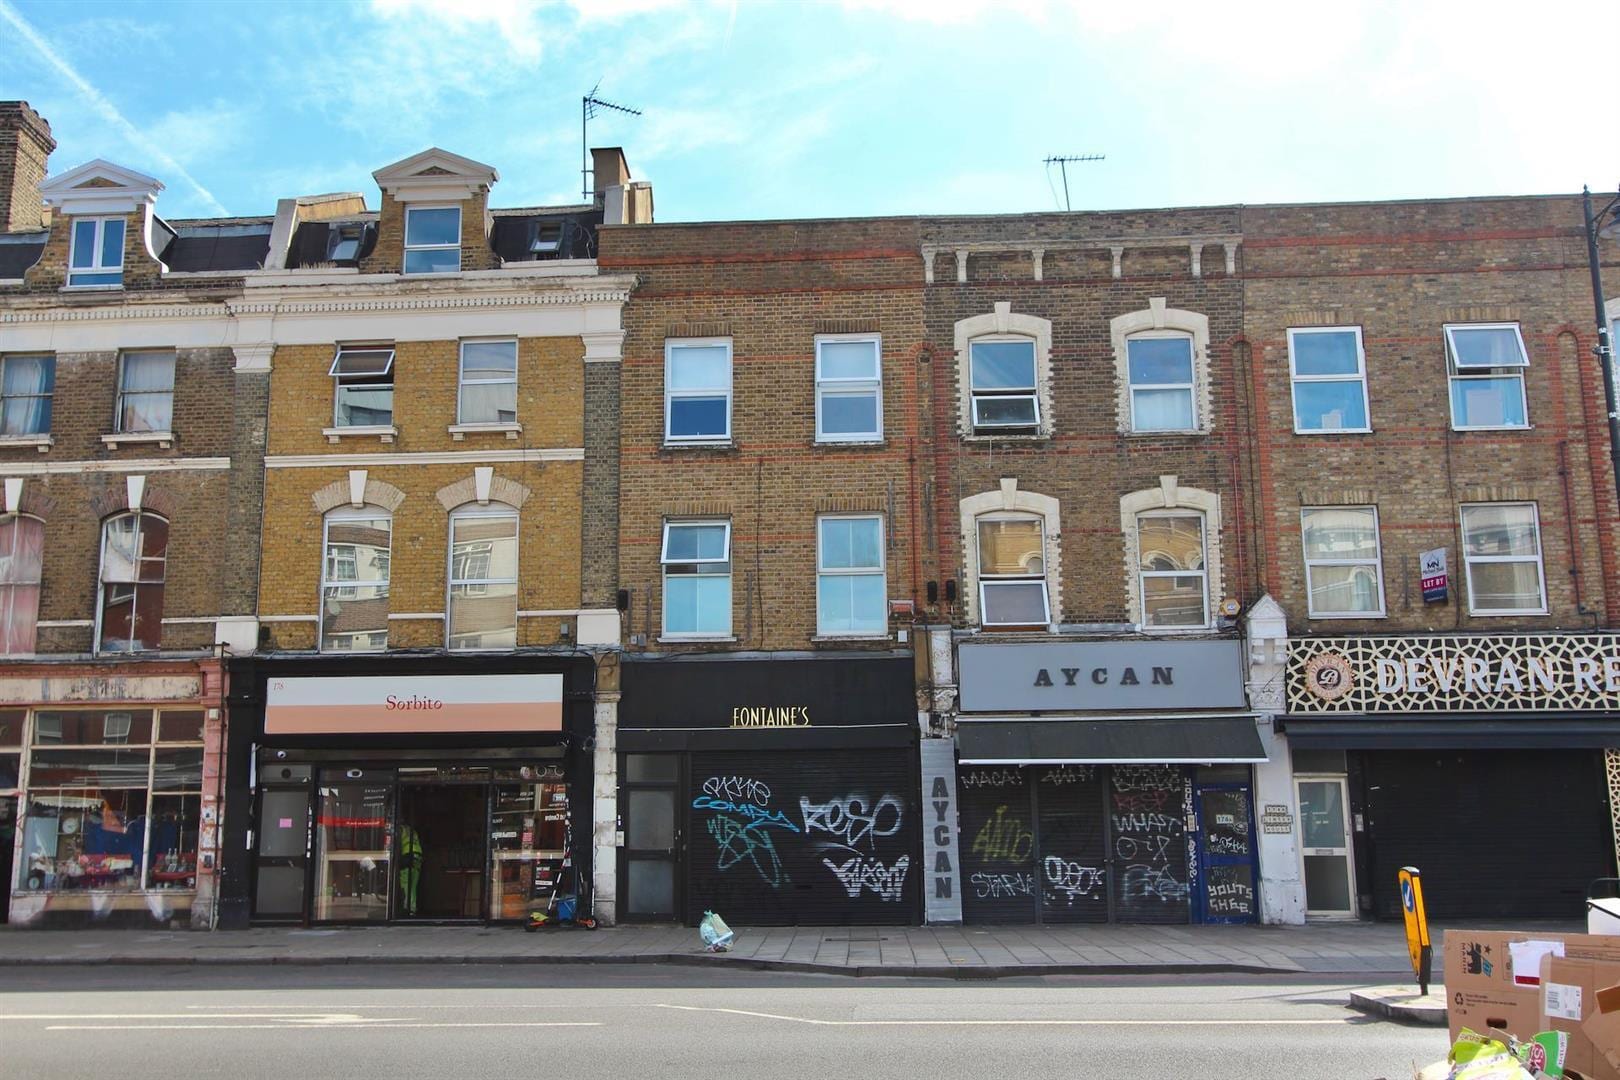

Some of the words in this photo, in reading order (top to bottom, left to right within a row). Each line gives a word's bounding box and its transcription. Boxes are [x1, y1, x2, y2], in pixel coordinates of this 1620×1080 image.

[1423, 579, 1435, 588] LET
[1435, 577, 1444, 586] BY
[1033, 666, 1174, 687] AYCAN
[1376, 656, 1554, 694] DEVRAN
[385, 694, 443, 711] Sorbito
[733, 706, 809, 727] FONTAINE'S
[931, 776, 952, 899] AYCAN
